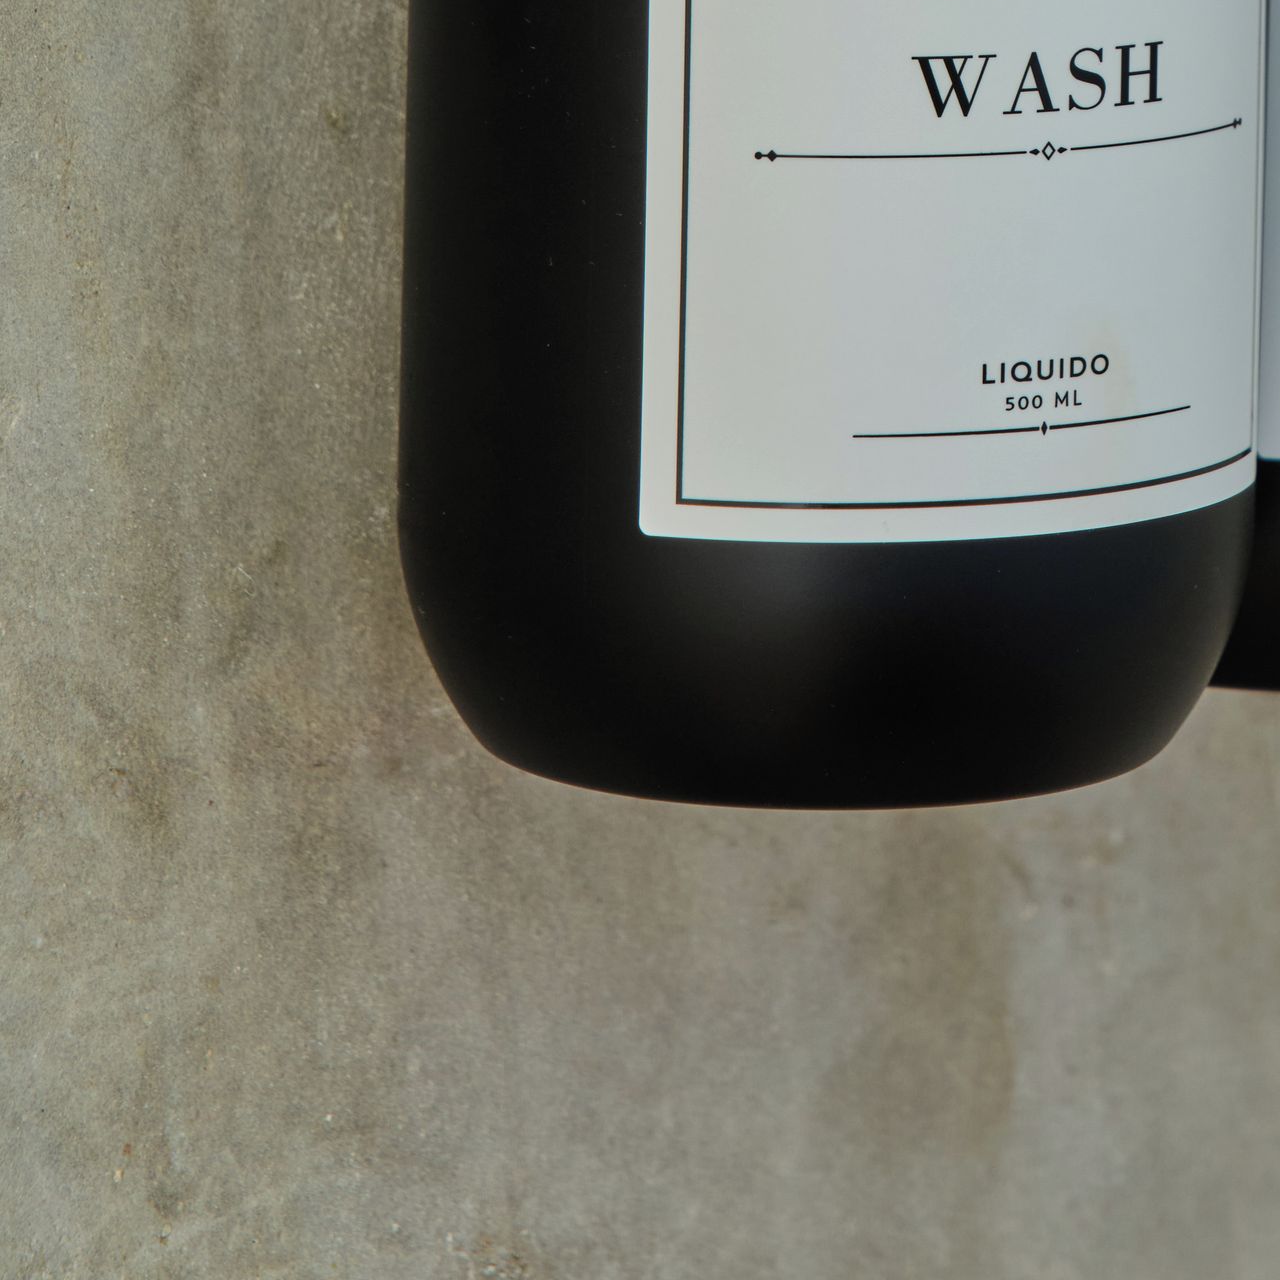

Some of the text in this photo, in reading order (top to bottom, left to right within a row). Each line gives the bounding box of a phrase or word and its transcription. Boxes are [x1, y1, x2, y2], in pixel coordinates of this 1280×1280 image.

[911, 40, 1164, 119] WASH
[981, 353, 1110, 385] LIQUIDO
[1005, 389, 1083, 412] 500 ML
